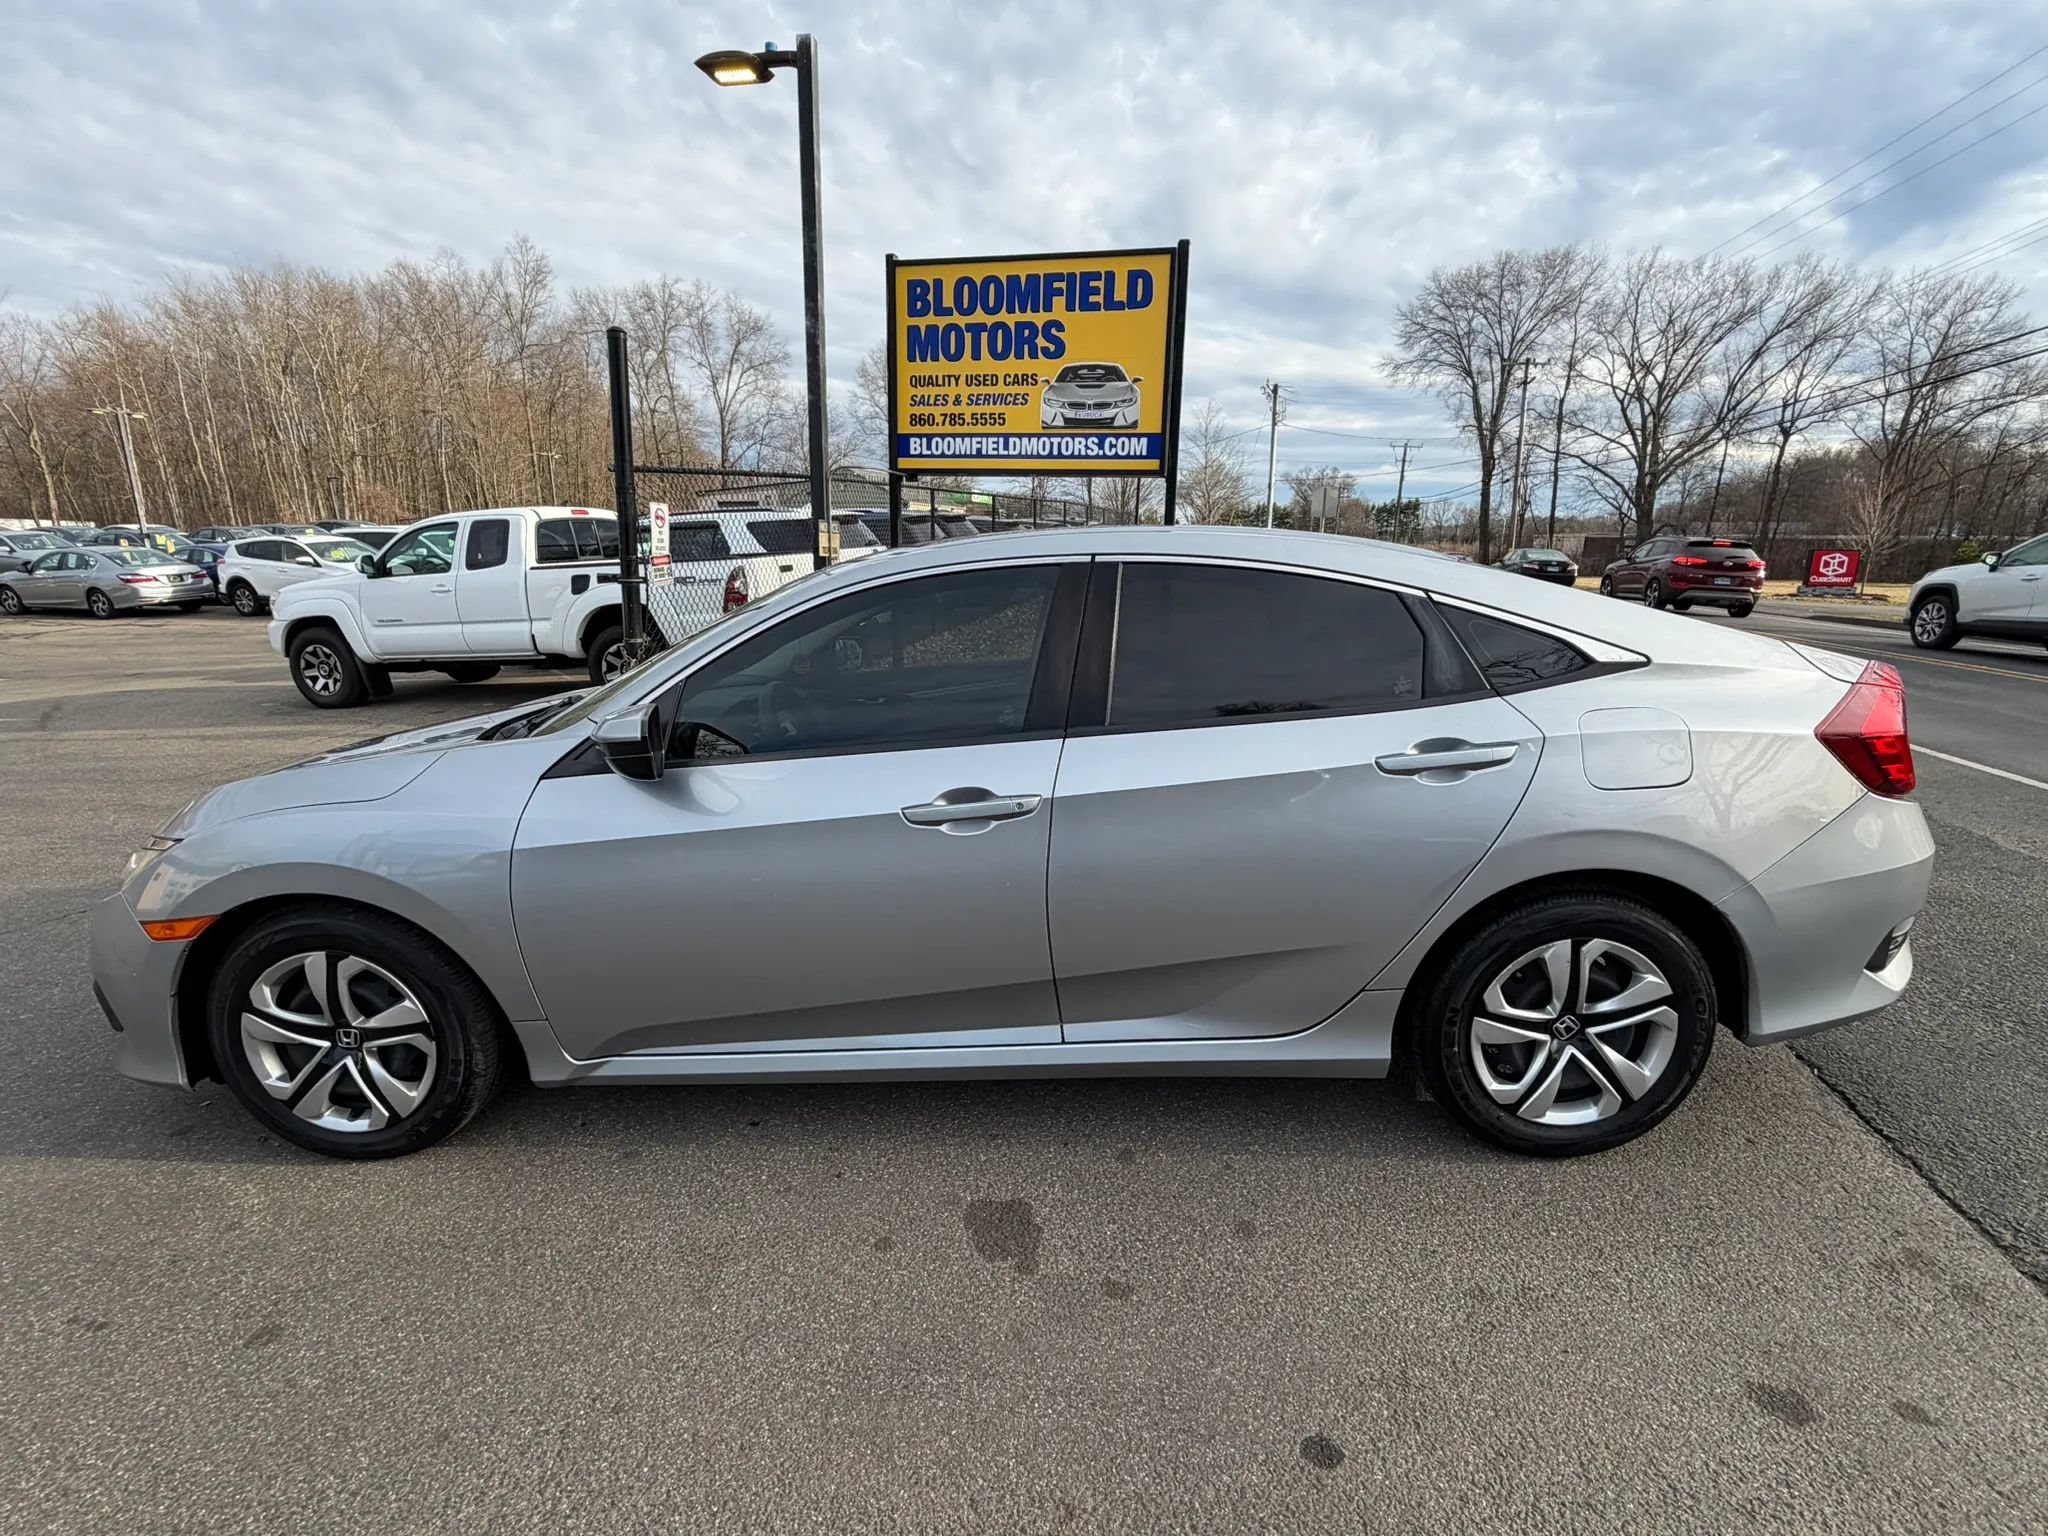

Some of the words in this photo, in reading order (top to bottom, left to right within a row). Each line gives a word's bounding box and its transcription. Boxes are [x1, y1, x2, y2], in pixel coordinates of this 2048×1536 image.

[906, 269, 1154, 318] BLOOMFIELD
[906, 319, 1066, 362] MOTORS
[909, 374, 960, 388] QUALITY
[965, 374, 999, 387] USED
[1003, 373, 1039, 387] CARS
[909, 394, 949, 407] SALES
[952, 394, 962, 407] &
[966, 393, 1030, 406] SERVICES
[909, 412, 1006, 427] 860.785.5555
[909, 437, 1148, 456] BLOOMFIELDMOTORS.COM
